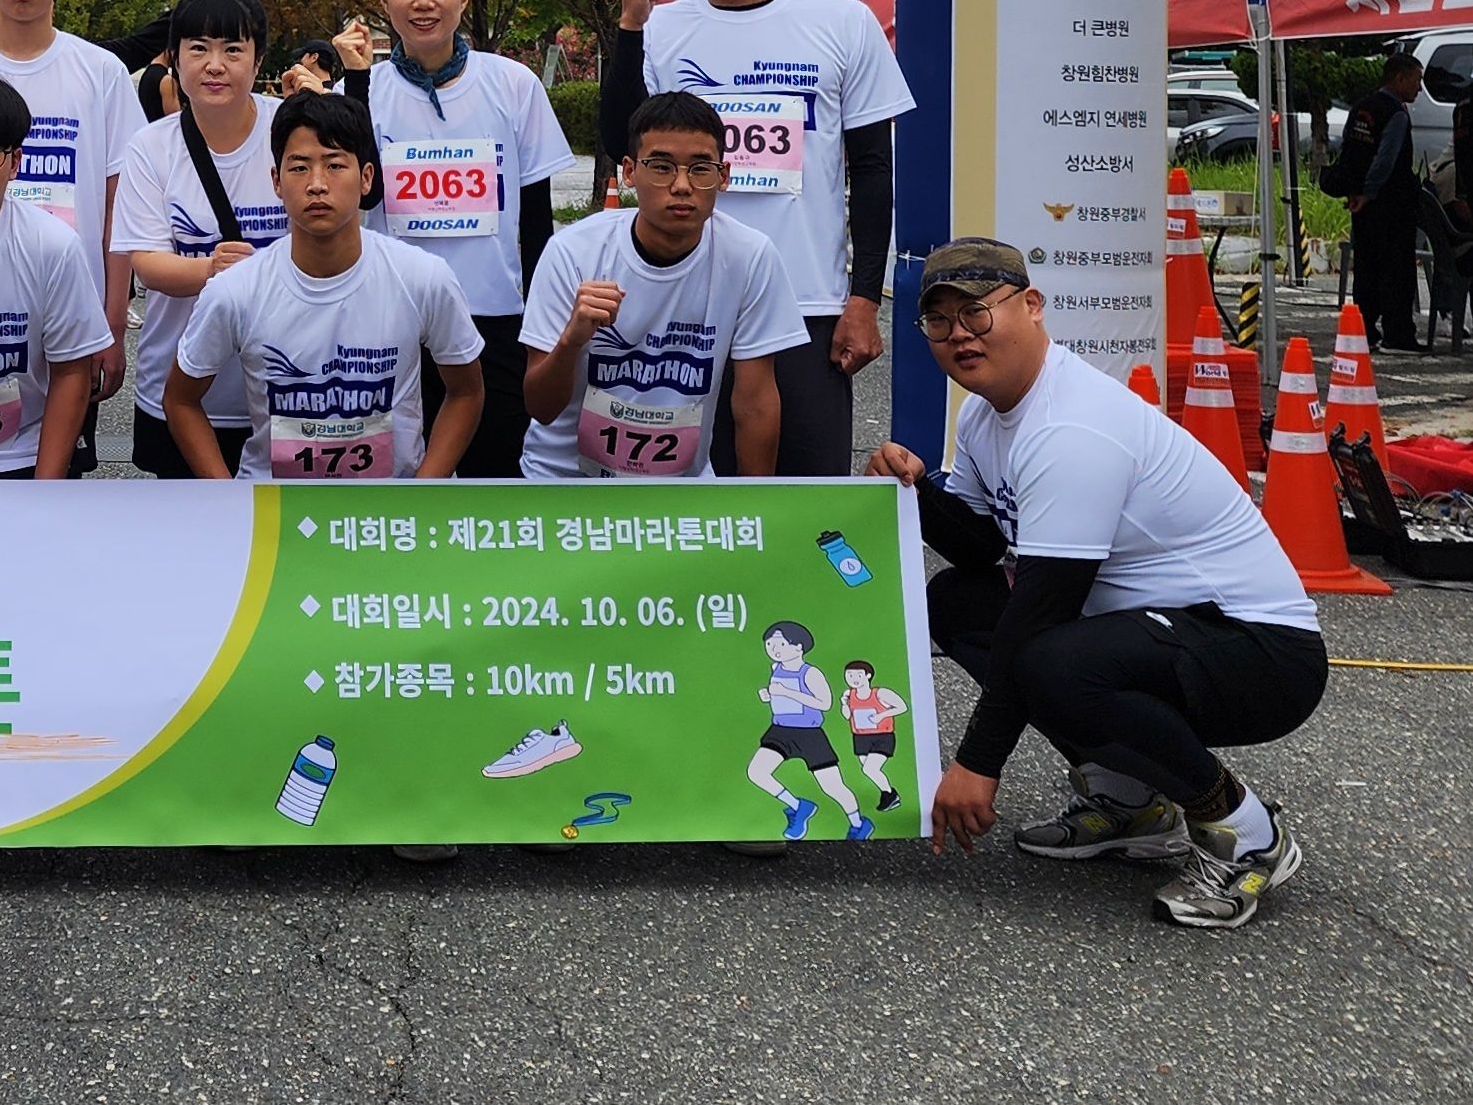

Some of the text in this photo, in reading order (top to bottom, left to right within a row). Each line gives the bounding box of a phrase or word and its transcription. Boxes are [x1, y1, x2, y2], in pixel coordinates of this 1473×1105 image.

[1073, 20, 1129, 37] 더 큰병원
[754, 61, 819, 74] Kyungnam
[1061, 65, 1139, 83] 창원힘찬병원
[733, 74, 819, 87] CHAMPIONSHIP
[32, 117, 79, 128] yungnam
[1043, 110, 1147, 128] 에스엠지 연세병원
[724, 124, 791, 154] 063
[406, 146, 474, 160] Bumhan
[21, 154, 71, 175] THON
[1065, 155, 1134, 173] 성산소방서
[395, 169, 487, 200] 2063
[730, 174, 779, 187] mhan
[1077, 207, 1147, 222] 창원중부경찰서
[407, 219, 479, 231] DOOSAN
[1053, 250, 1153, 267] 창원중부모범운전자회
[1053, 295, 1153, 311] 창원서부모범운전자회
[337, 344, 399, 359] Kyungnam
[322, 359, 397, 375] CHAMPIONSHIP
[597, 359, 704, 388] MARATHON
[275, 386, 386, 412] MARATHON
[599, 425, 680, 462] 172
[294, 444, 374, 472] 173
[329, 517, 417, 552] 대회명
[448, 517, 545, 552] 제21회
[555, 517, 764, 552] 경남마라톤대회
[333, 595, 452, 630] 대회일시
[483, 597, 568, 627] 2024.
[581, 597, 627, 627] 10.
[638, 597, 684, 627] 06.
[695, 595, 748, 632] (일)
[334, 664, 454, 699] 참가종목
[487, 664, 574, 696] 10km
[606, 664, 675, 696] 5km
